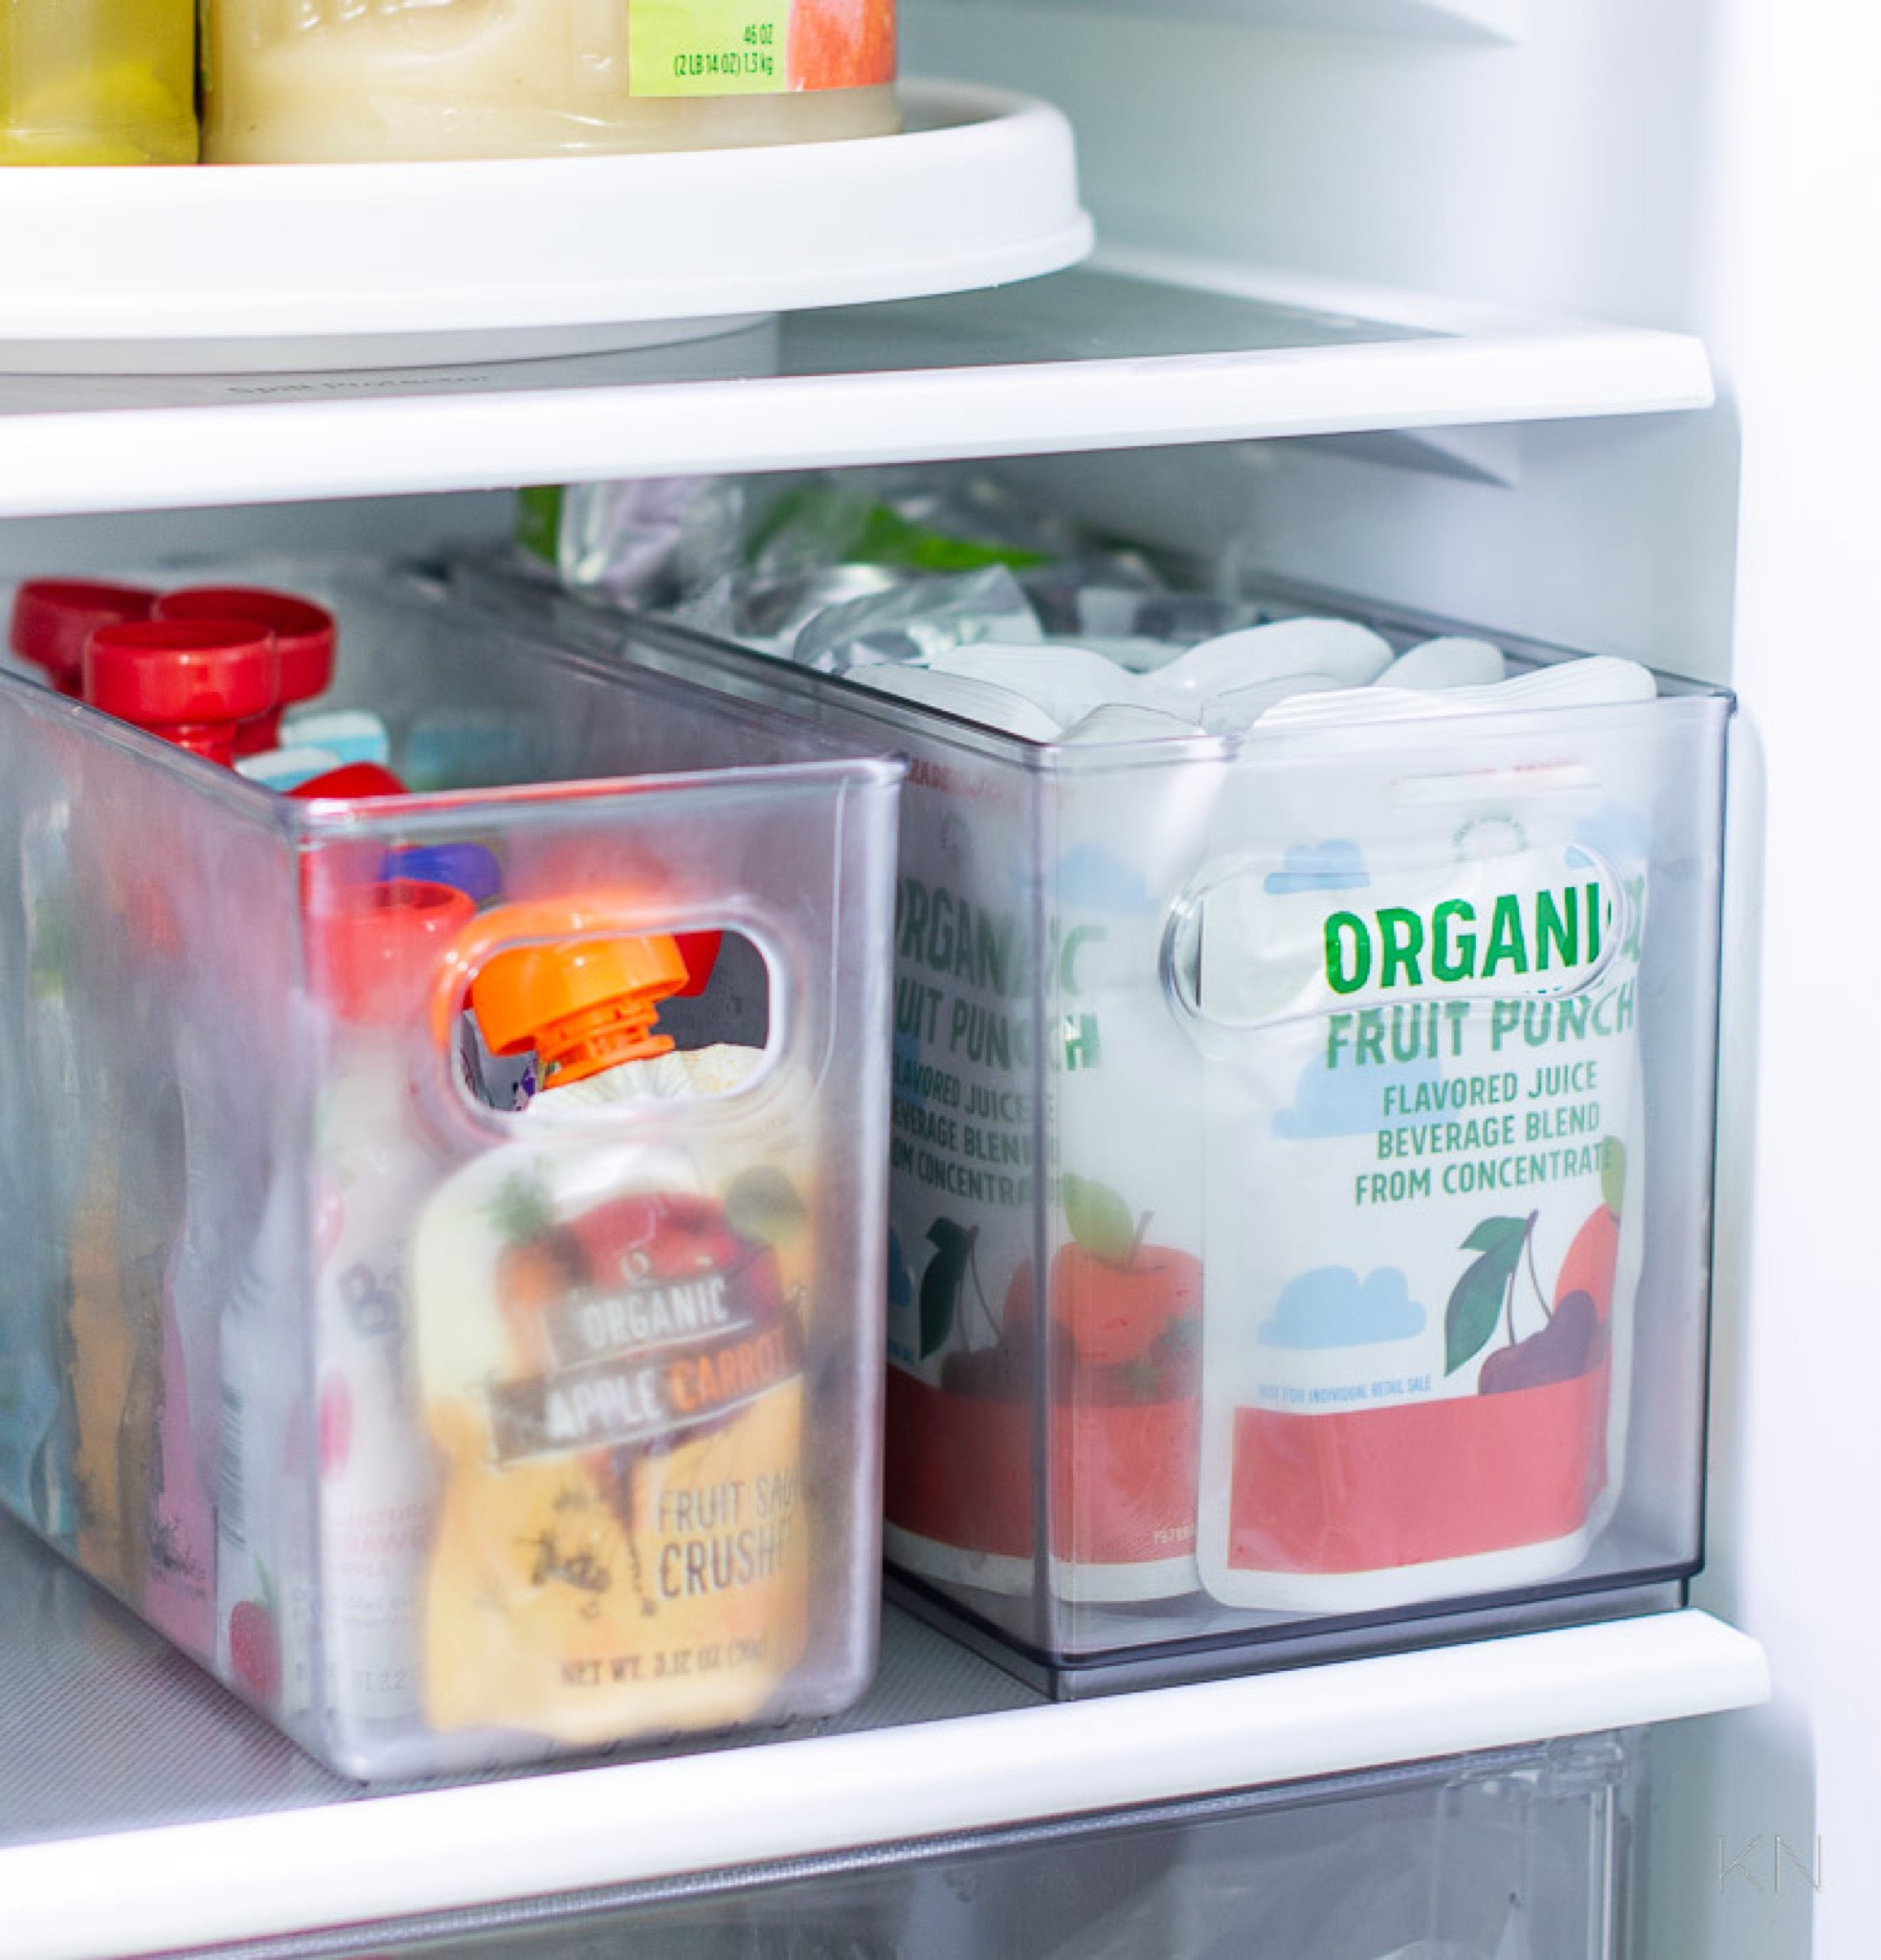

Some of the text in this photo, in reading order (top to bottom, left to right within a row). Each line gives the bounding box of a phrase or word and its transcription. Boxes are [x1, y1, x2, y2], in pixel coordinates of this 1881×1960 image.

[759, 24, 773, 45] OZ
[674, 54, 686, 77] (2
[688, 54, 704, 76] LB
[721, 52, 742, 77] OZ)
[761, 52, 773, 76] kg
[1324, 875, 1645, 995] ORGANI
[1326, 977, 1636, 1069] FRUIT PUNCH
[1382, 1060, 1598, 1117] FLAVORED JUICE
[1377, 1102, 1601, 1160] BEVERAGE BLEND
[1355, 1141, 1615, 1205] FROM CONCENTRATE
[579, 1275, 730, 1349] ORGANIC
[545, 1370, 662, 1437] APPLE
[1309, 1384, 1367, 1404] INDIVIDUAL
[1371, 1378, 1403, 1396] RETAIL
[1407, 1373, 1432, 1392] SALE
[656, 1481, 745, 1533] FRUIT
[561, 1659, 603, 1685] NET
